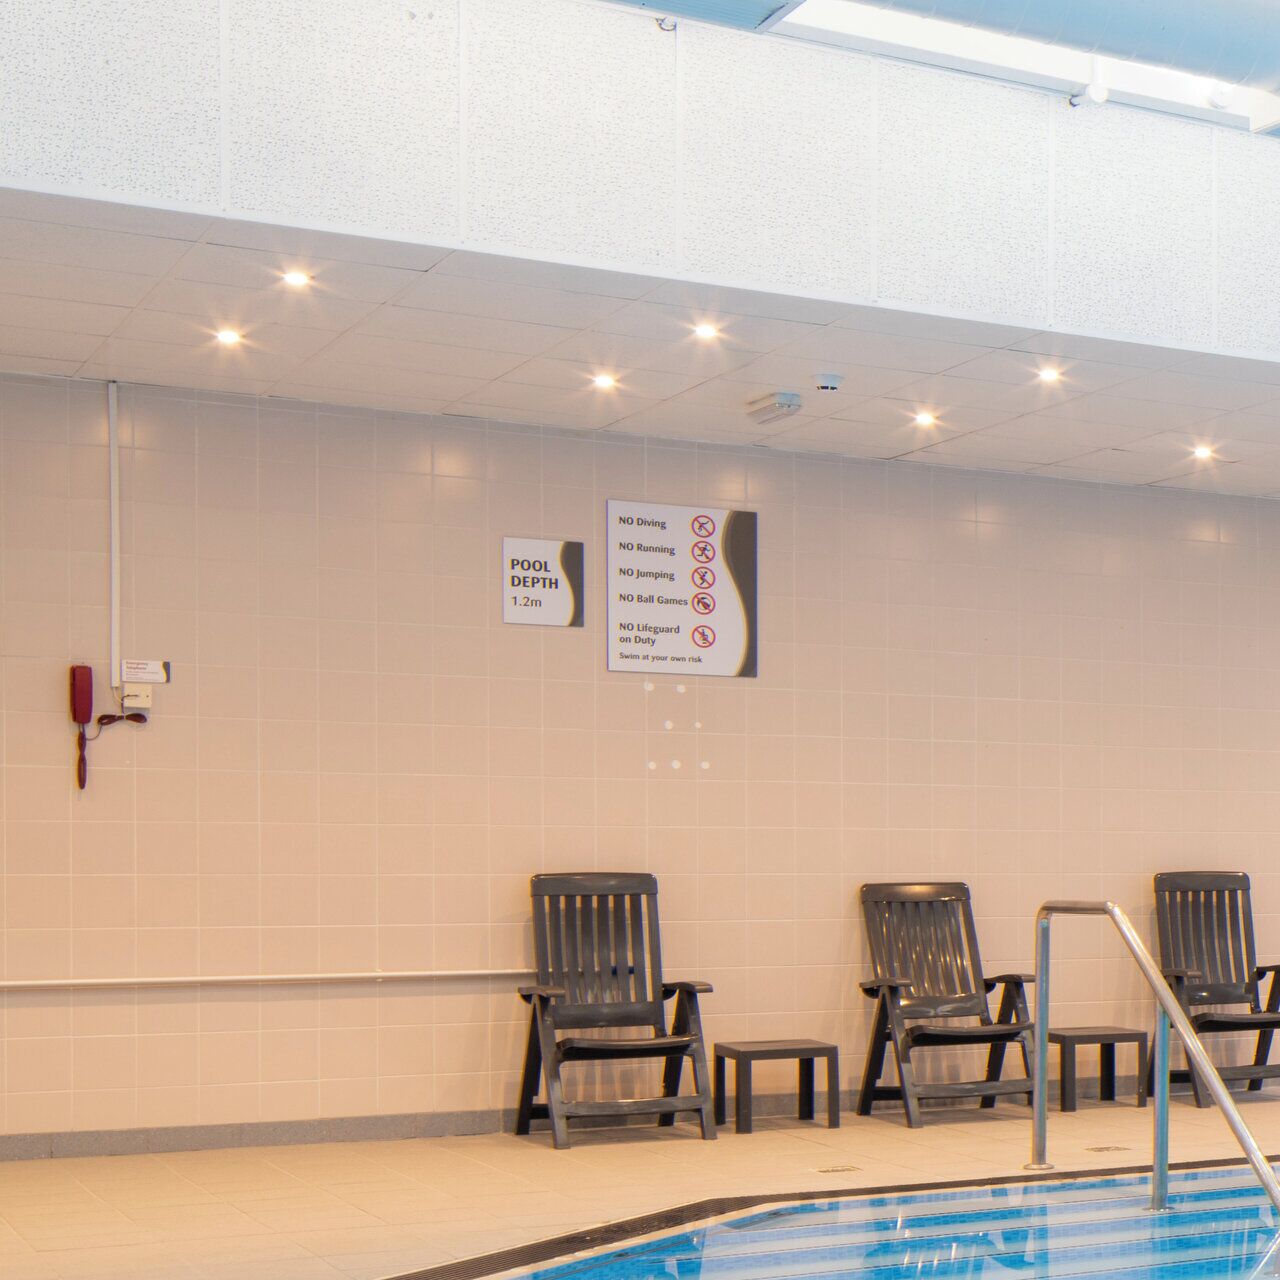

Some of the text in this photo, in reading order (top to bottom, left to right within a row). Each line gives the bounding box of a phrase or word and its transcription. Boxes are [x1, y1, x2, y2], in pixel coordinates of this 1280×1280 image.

[619, 516, 667, 530] NO Diving
[619, 542, 676, 556] NO Running
[511, 558, 551, 573] POOL
[619, 567, 675, 582] NO Jumping
[511, 575, 559, 589] DEPTH
[511, 596, 542, 607] 1.2m
[619, 593, 688, 606] NO Ball Games
[619, 622, 680, 635] NO Lifeguard
[634, 635, 656, 647] Duty
[619, 651, 640, 660] Swim
[651, 655, 668, 663] your
[688, 655, 703, 663] risk
